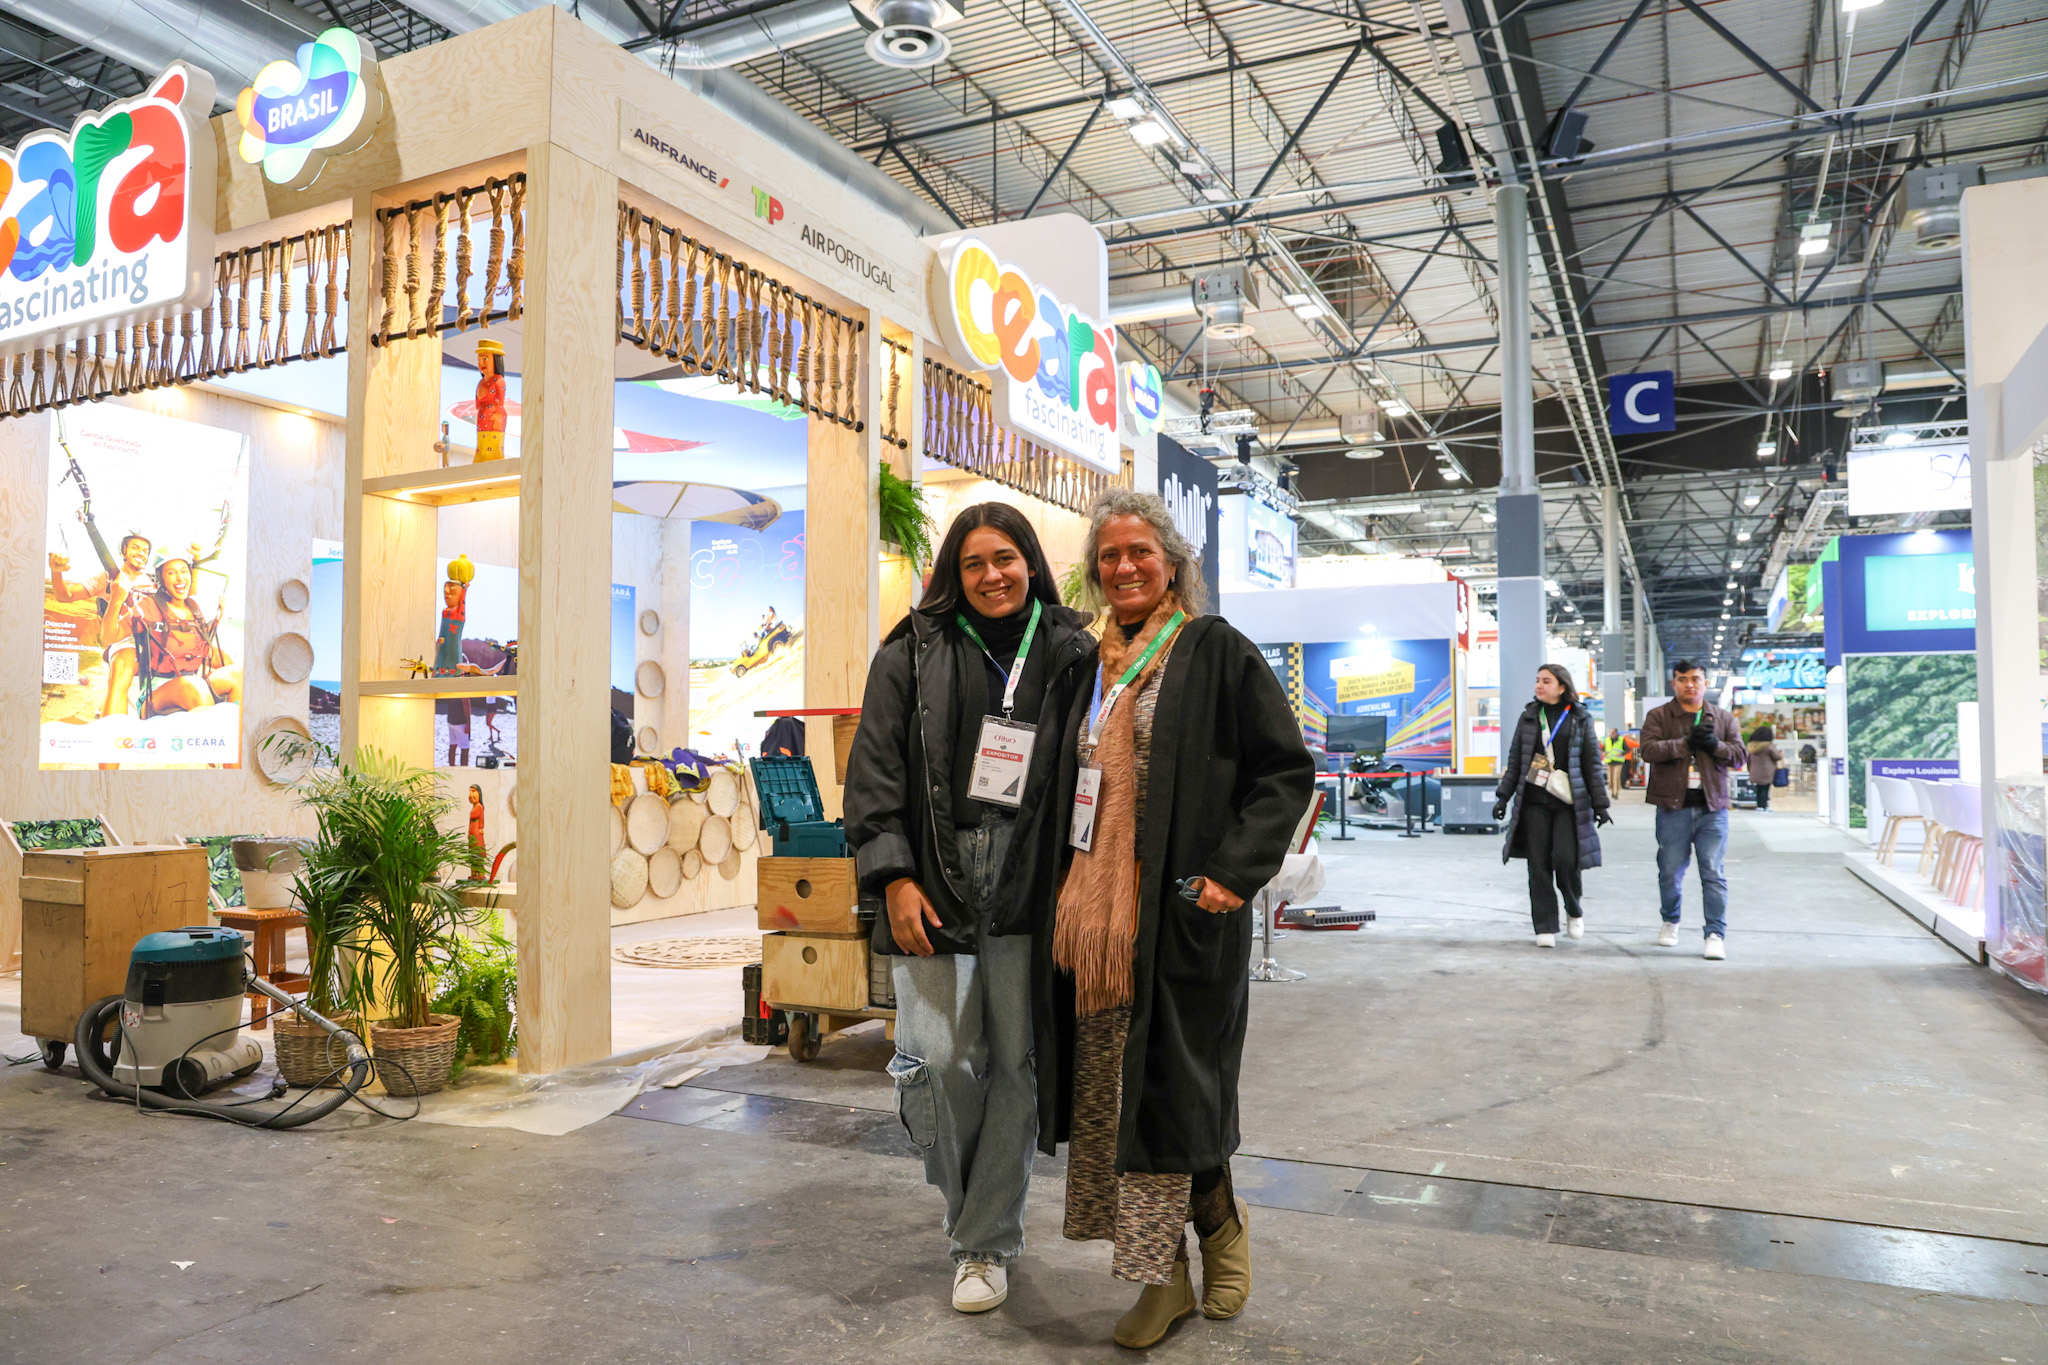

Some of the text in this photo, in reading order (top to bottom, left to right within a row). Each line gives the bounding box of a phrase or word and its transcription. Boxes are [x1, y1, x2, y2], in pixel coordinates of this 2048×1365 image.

[268, 88, 339, 133] BRASIL
[0, 73, 187, 282] ará
[634, 128, 717, 183] AIRFRANCE
[752, 185, 784, 225] TAP
[0, 253, 149, 330] ascinating
[955, 247, 1117, 433] ceará
[1025, 387, 1106, 460] fascinating
[1623, 380, 1661, 424] C
[1907, 608, 1976, 622] EXPLOR
[187, 736, 226, 747] CEARÁ
[986, 750, 1019, 760] EXPOSITOR
[1881, 766, 1959, 776] Explore Louisiana
